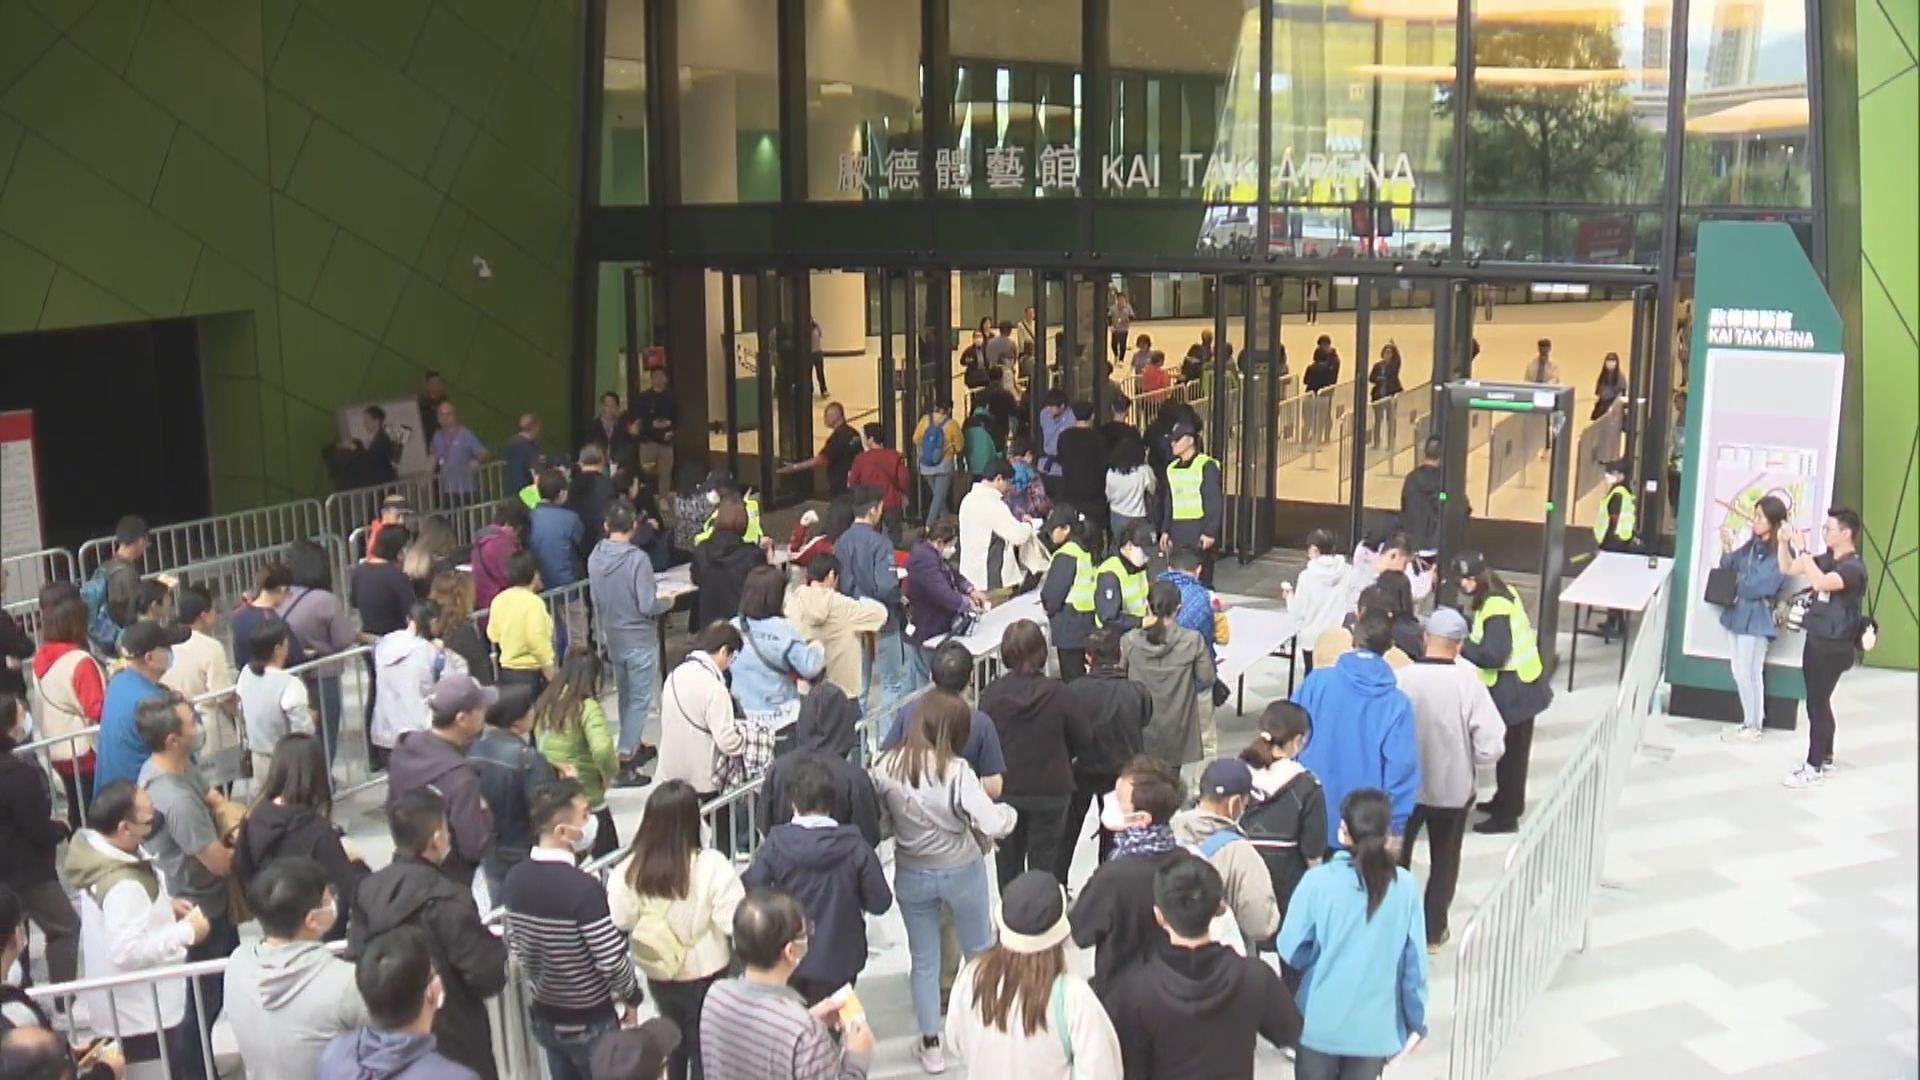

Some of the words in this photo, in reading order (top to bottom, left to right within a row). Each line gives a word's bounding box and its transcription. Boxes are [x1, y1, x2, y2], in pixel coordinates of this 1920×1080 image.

[1101, 153, 1160, 189] KAI
[1180, 153, 1255, 189] TAK
[1277, 152, 1416, 189] ARENA
[1709, 328, 1733, 343] KAI
[1736, 329, 1762, 345] TAK
[1764, 330, 1814, 348] ARENA
